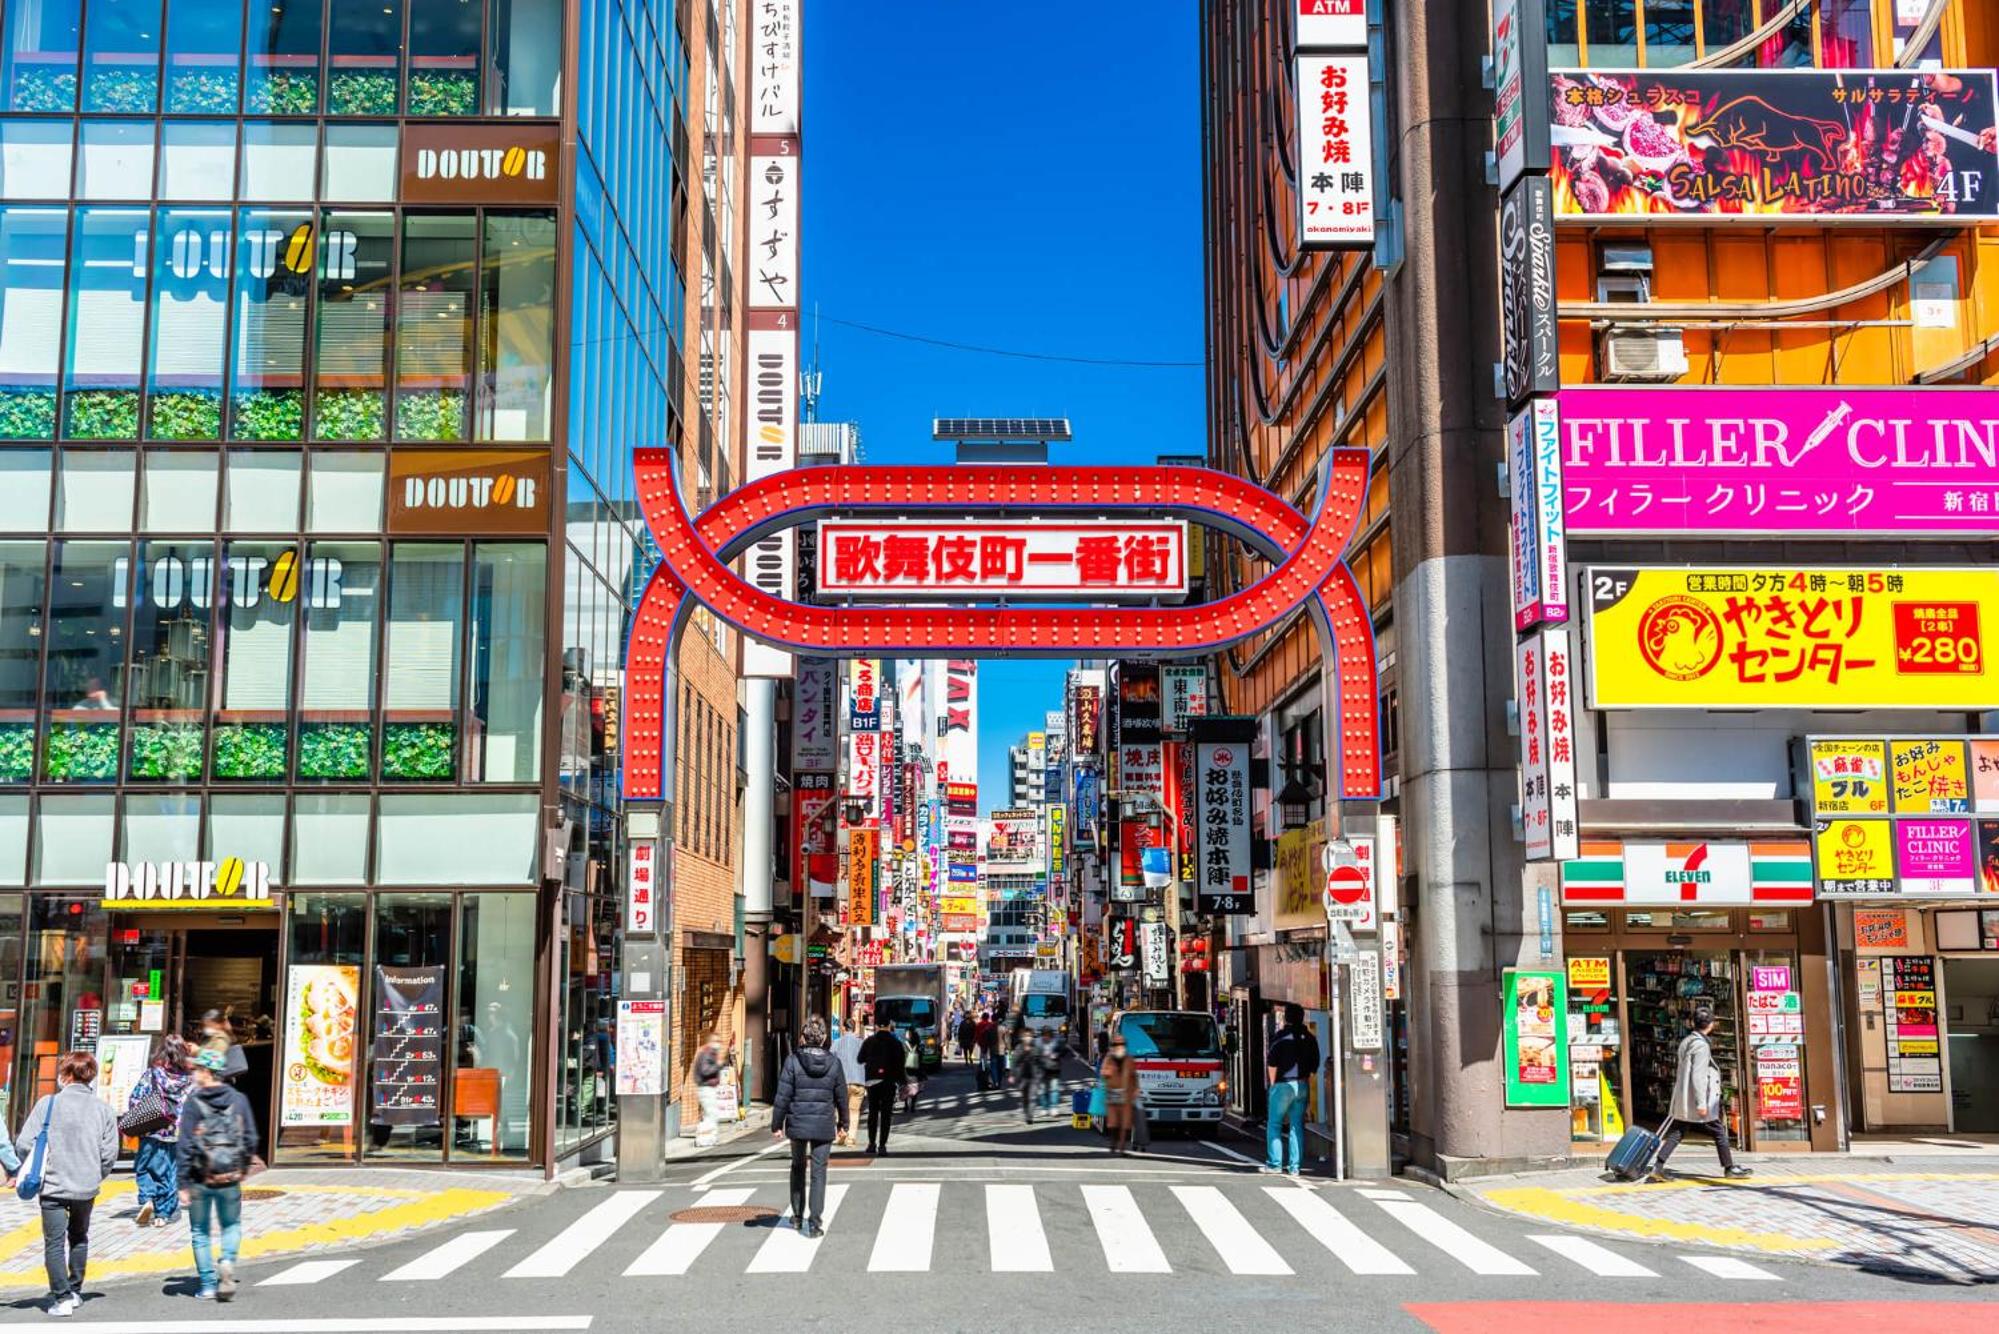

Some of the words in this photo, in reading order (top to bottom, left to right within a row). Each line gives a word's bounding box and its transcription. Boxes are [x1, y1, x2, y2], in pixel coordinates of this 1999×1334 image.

[1313, 0, 1350, 14] ATM
[760, 2, 783, 117] ちびすけバル
[1566, 88, 1700, 107] 本格シュラスコ
[1831, 87, 1975, 105] サルサラティーノ
[1320, 65, 1351, 164] お好み焼
[780, 141, 790, 154] 5
[417, 147, 546, 180] DOUTOR
[1311, 172, 1364, 194] 本陣
[1669, 164, 1754, 202] SALSA
[1936, 171, 1982, 203] 4F
[1307, 225, 1371, 233] okonomiyaki
[760, 190, 788, 303] すずや
[1529, 223, 1551, 312] Sparkle
[777, 314, 788, 327] 4
[1535, 314, 1555, 377] スパークル
[757, 353, 784, 461] DOUTOR
[1563, 418, 1794, 468] FILLER
[405, 474, 535, 509] DOUTOR
[1538, 421, 1562, 544] ファイトフィット
[1567, 485, 1692, 515] フィラー
[1705, 483, 1874, 516] クリニック
[834, 534, 1171, 583] 歌舞伎町一番街
[1547, 545, 1559, 601] 新宿歌舞伎町
[1688, 575, 1747, 591] 営業時間
[1595, 577, 1627, 600] 2F
[1722, 596, 1864, 640] やきとり
[1728, 641, 1876, 684] センター
[1524, 650, 1539, 765] お好み焼
[1549, 651, 1570, 763] お好み焼
[853, 717, 877, 728] B1F
[1895, 742, 1941, 767] お好み
[800, 775, 829, 789] 焼肉
[1896, 754, 1957, 783] もんじゃ
[1896, 775, 1966, 801] たこ焼き
[1555, 783, 1573, 837] 本陣
[1818, 801, 1849, 811] 新宿店
[1869, 800, 1885, 811] 6F
[1206, 768, 1230, 886] お好み焼本陣
[1907, 826, 1959, 838] FILLER
[1835, 850, 1873, 861] やきとり
[1908, 841, 1960, 853] CLINIC
[106, 857, 270, 900] DOUTOR
[1838, 863, 1877, 874] センター
[634, 846, 650, 924] 劇場通り
[1823, 881, 1892, 892] 朝まで営業中
[1571, 960, 1608, 968] ATM
[1758, 972, 1786, 987] SIM
[1749, 995, 1778, 1008] たばこ
[1785, 994, 1798, 1008] 酒
